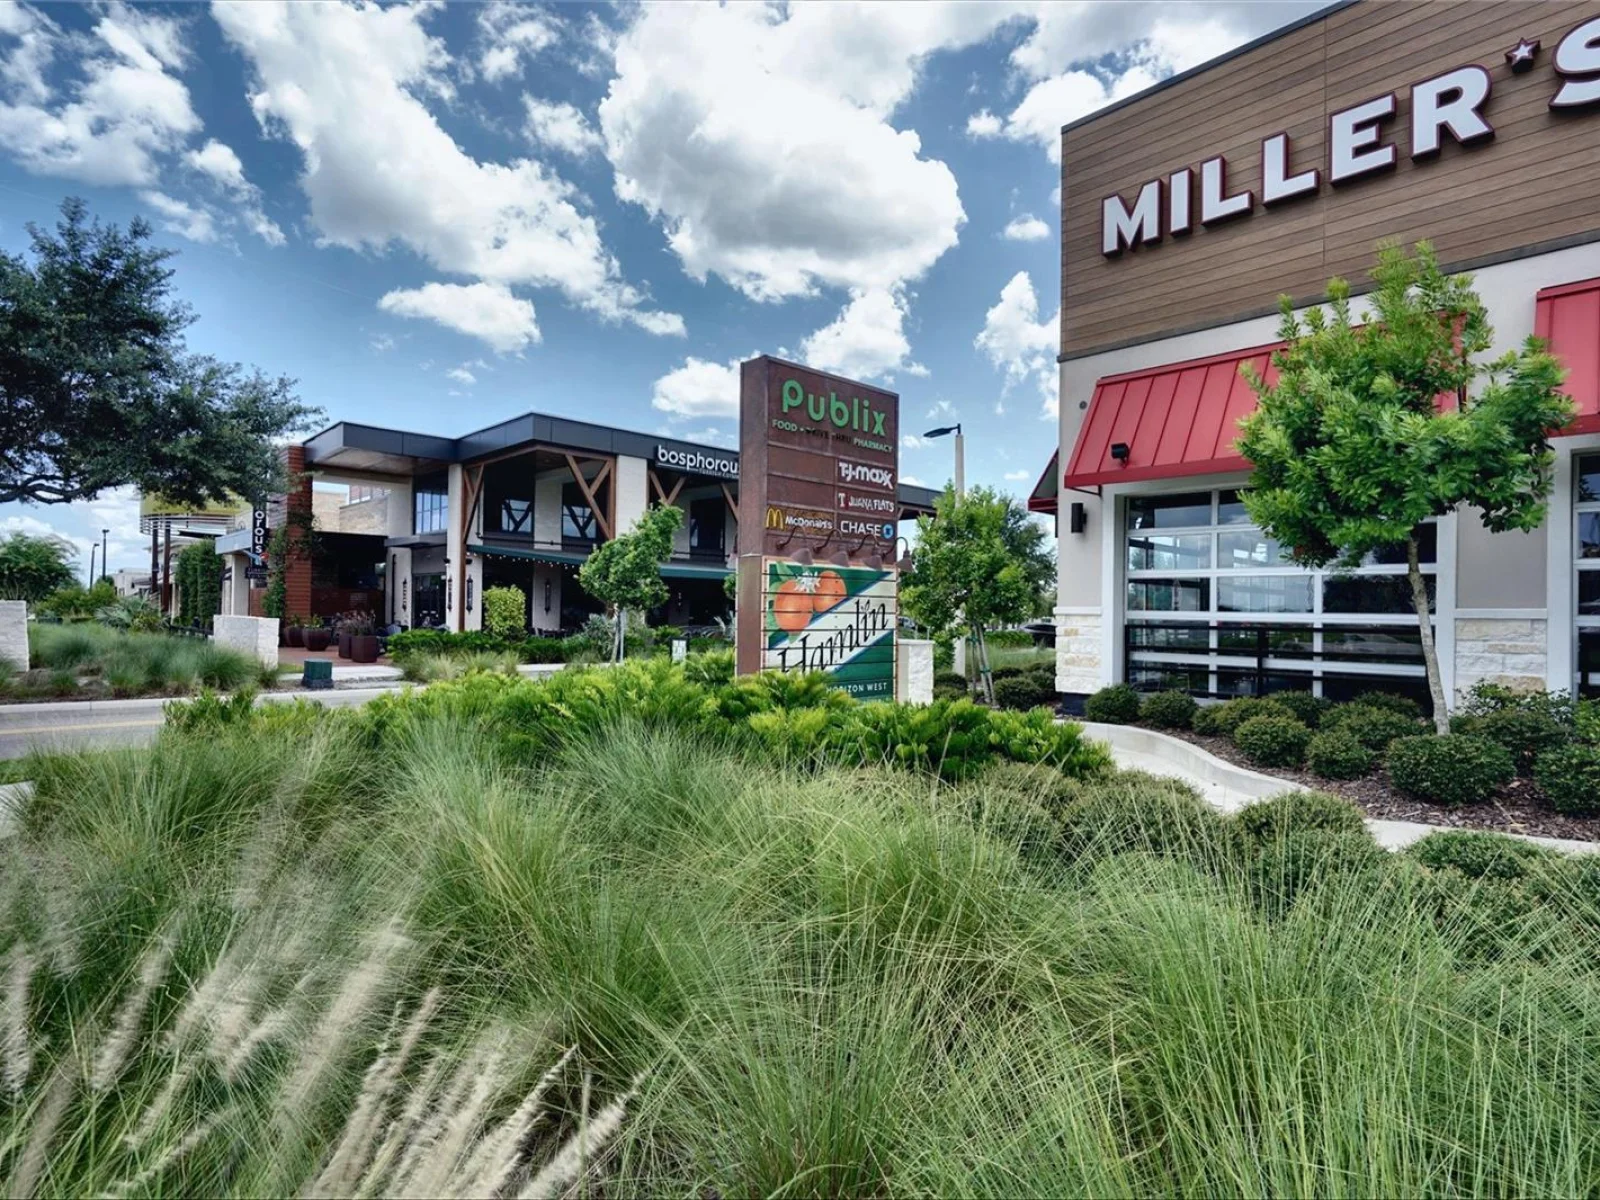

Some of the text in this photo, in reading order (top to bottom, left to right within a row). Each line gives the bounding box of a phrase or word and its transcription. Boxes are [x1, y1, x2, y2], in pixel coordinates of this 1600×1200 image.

[781, 378, 886, 436] Publix
[771, 419, 798, 432] FOOD
[853, 437, 893, 453] PHARMACY
[658, 444, 738, 474] bosphorou
[840, 520, 882, 537] CHASE
[777, 598, 889, 674] Hamlin
[866, 682, 887, 691] WEST
